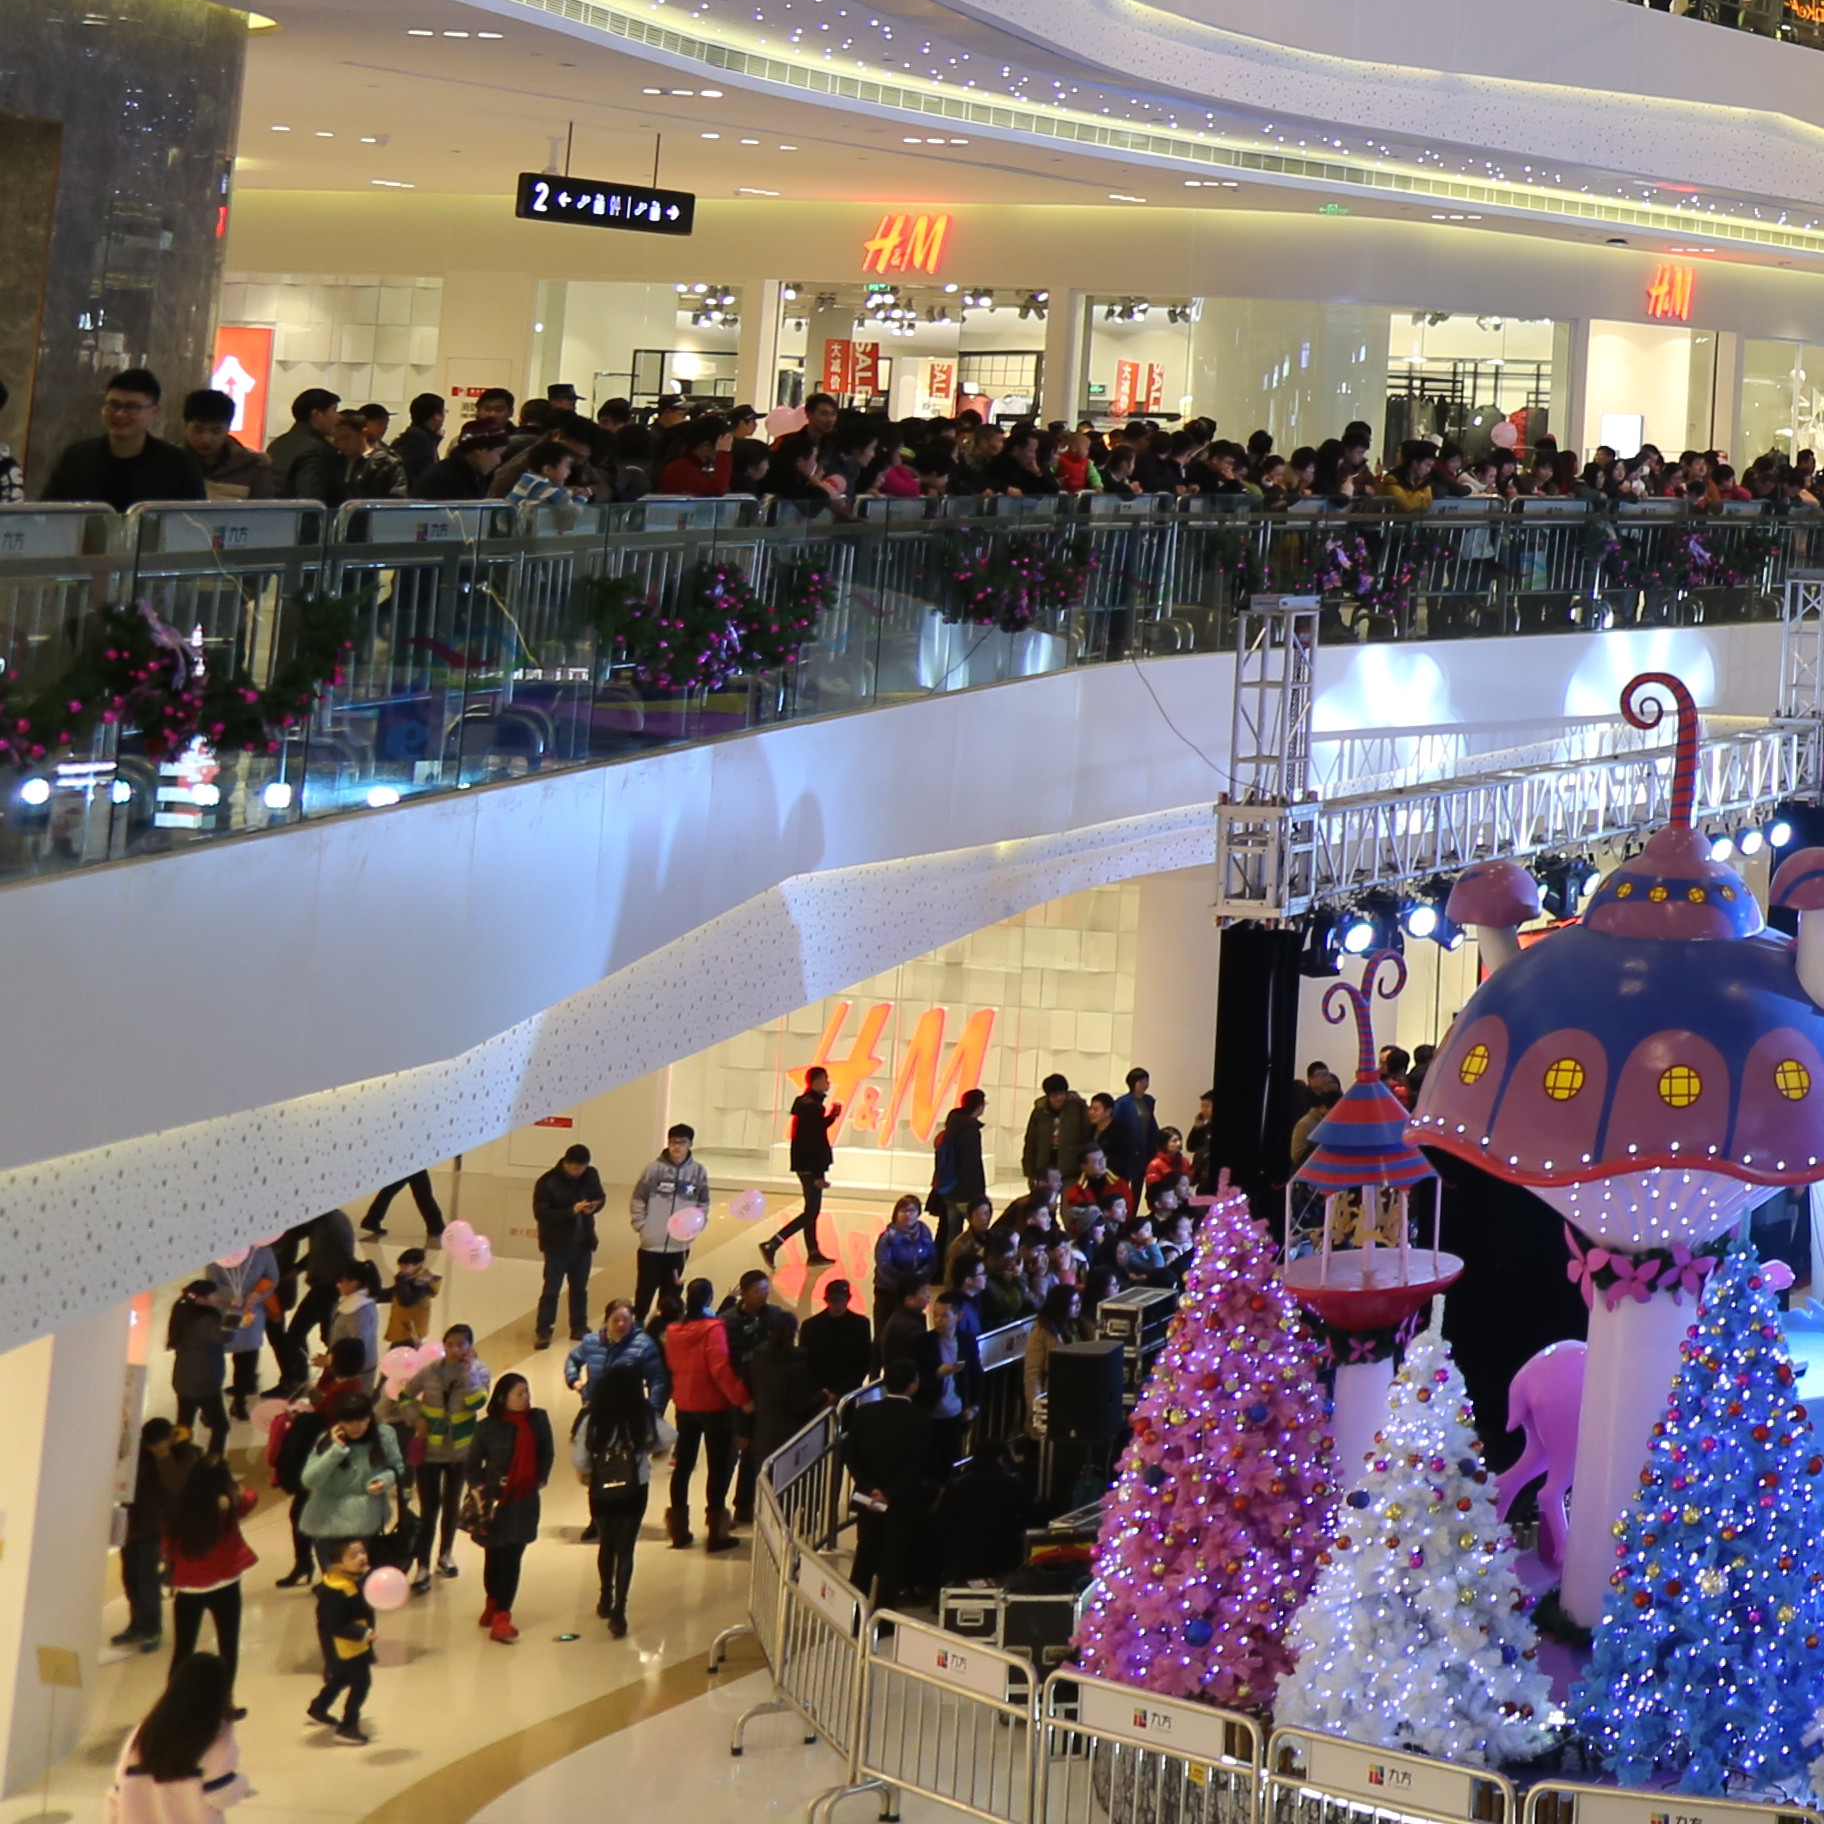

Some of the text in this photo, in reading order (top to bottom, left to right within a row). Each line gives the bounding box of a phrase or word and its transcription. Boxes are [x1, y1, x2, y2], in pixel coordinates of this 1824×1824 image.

[532, 182, 551, 213] 2
[862, 214, 953, 274] H&M
[1646, 263, 1697, 321] H&M
[781, 999, 999, 1149] H&M
